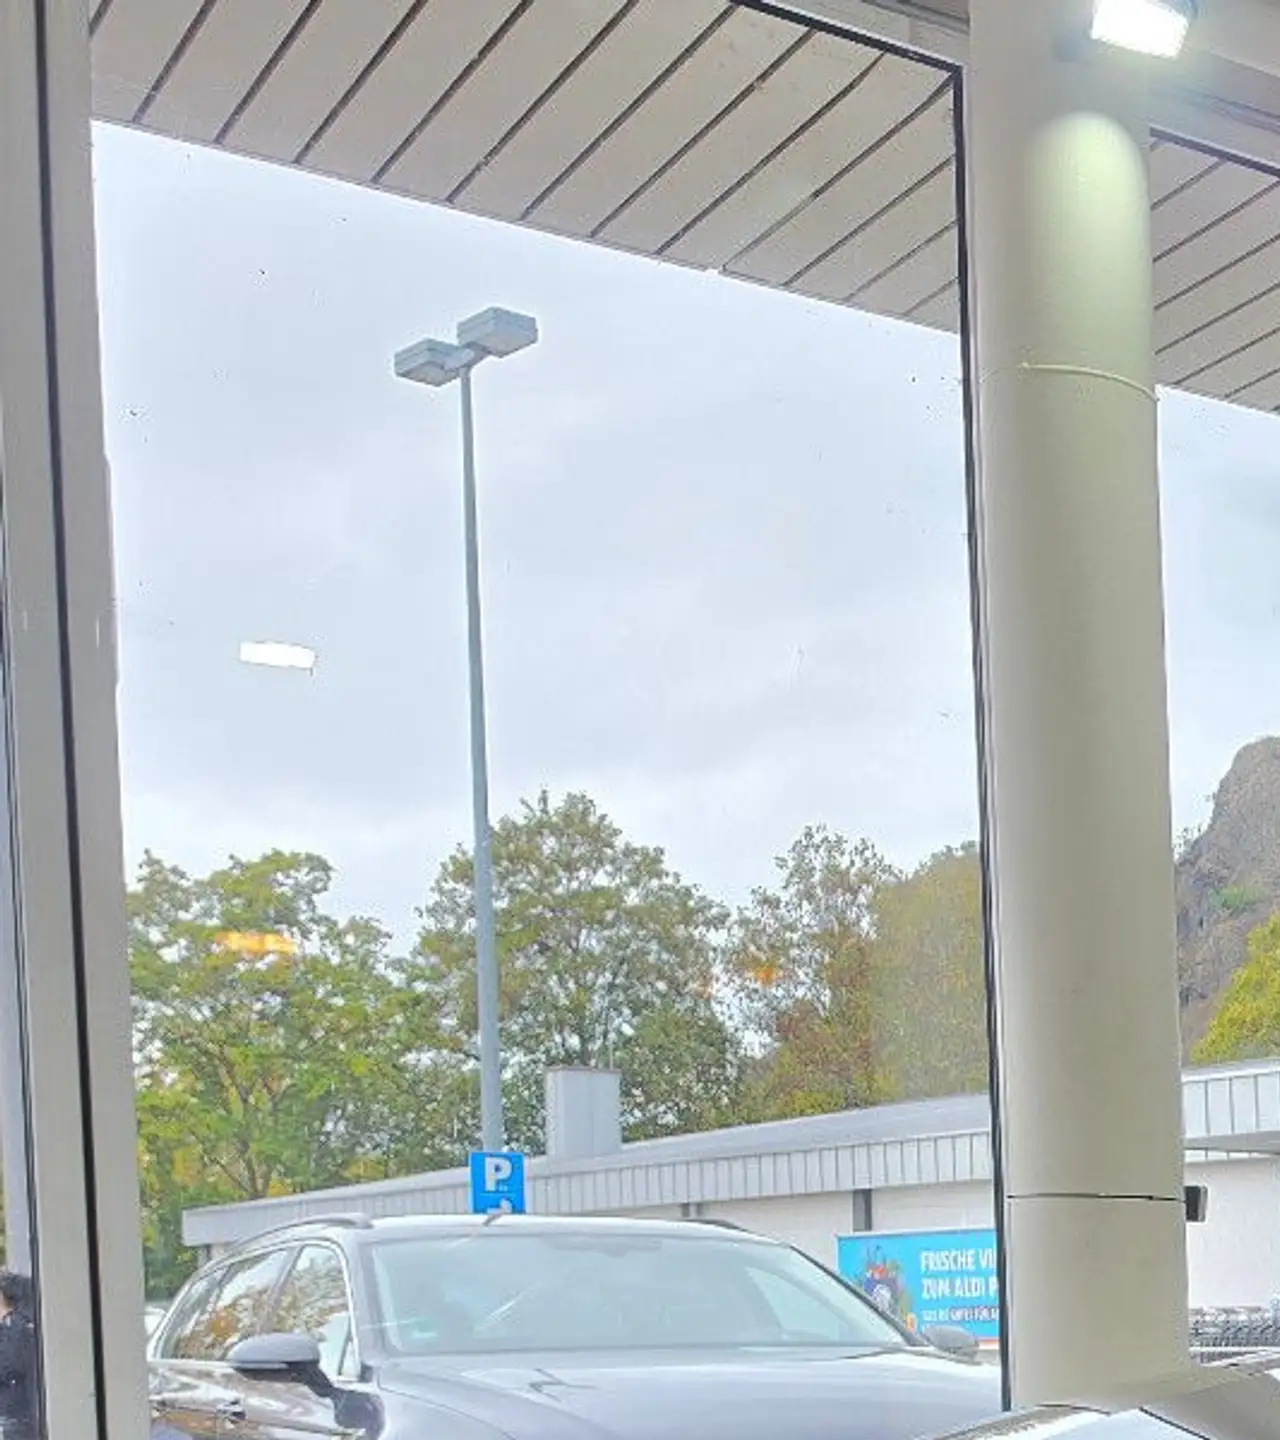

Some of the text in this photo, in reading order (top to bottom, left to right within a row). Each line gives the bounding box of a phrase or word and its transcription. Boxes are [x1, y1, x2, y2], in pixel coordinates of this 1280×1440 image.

[485, 1157, 512, 1191] P
[921, 1250, 976, 1273] FRISCHE
[954, 1276, 985, 1298] ALDI
